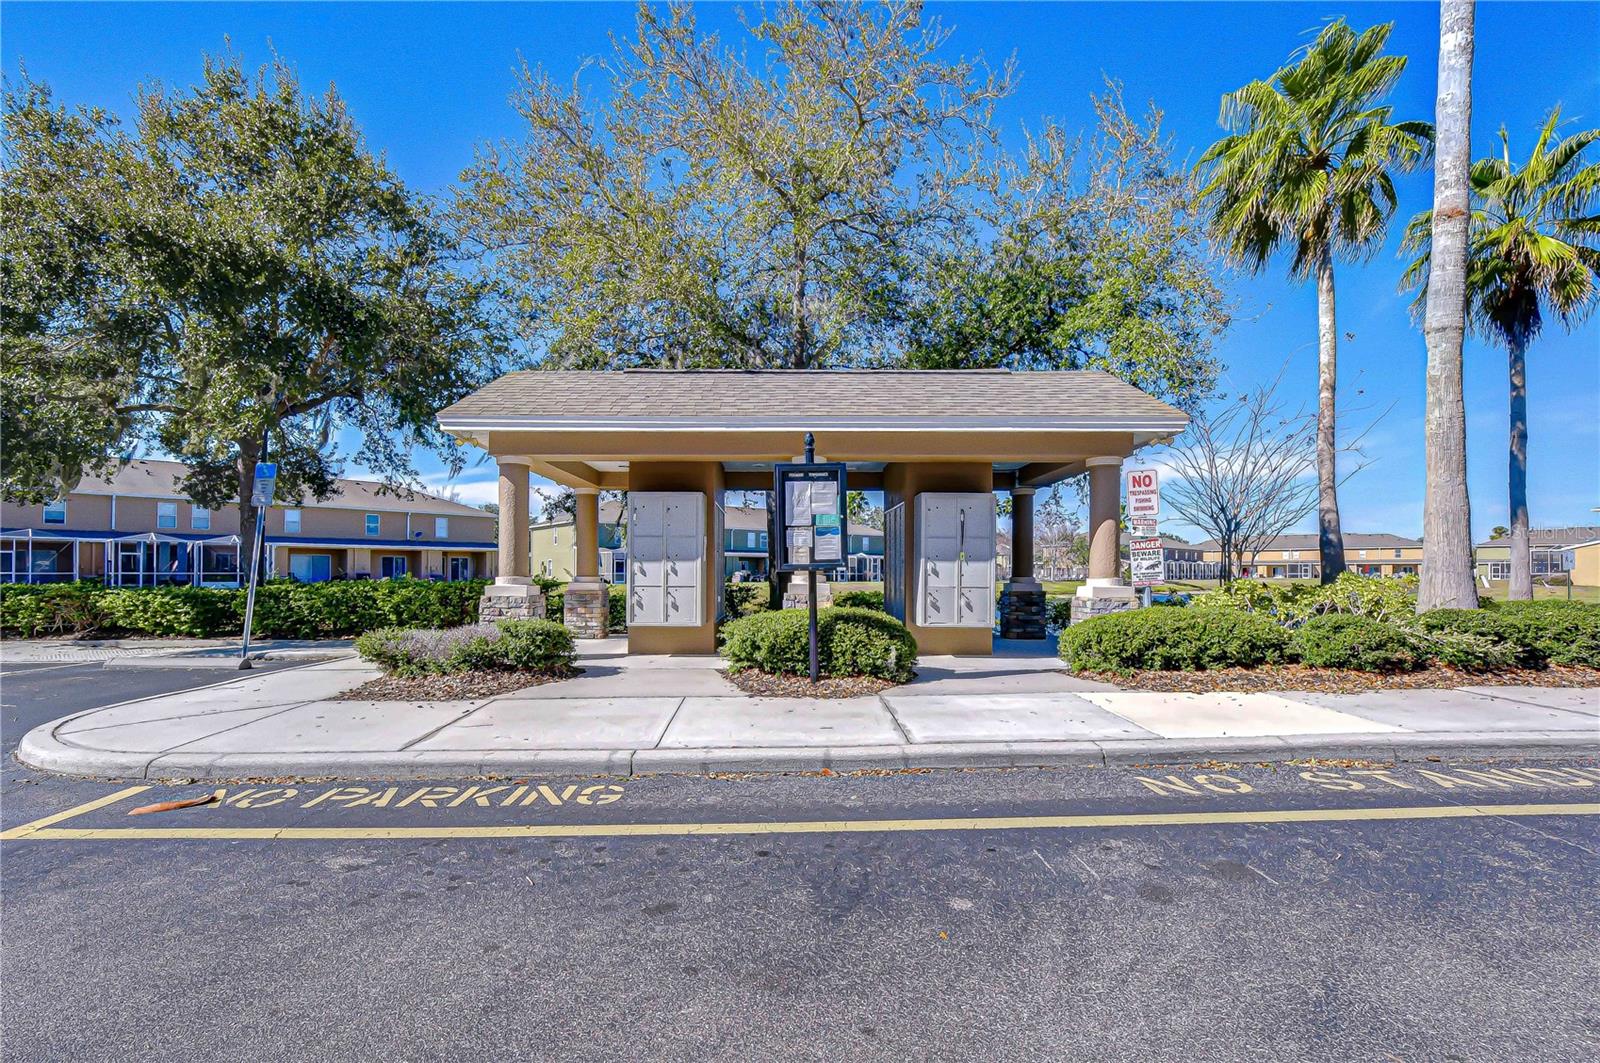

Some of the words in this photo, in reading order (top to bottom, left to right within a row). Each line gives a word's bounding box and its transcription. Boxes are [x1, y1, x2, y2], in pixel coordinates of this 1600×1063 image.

[1132, 475, 1152, 488] NO
[1131, 541, 1161, 549] DANGER
[1133, 775, 1253, 796] NO
[300, 785, 626, 808] PARKING
